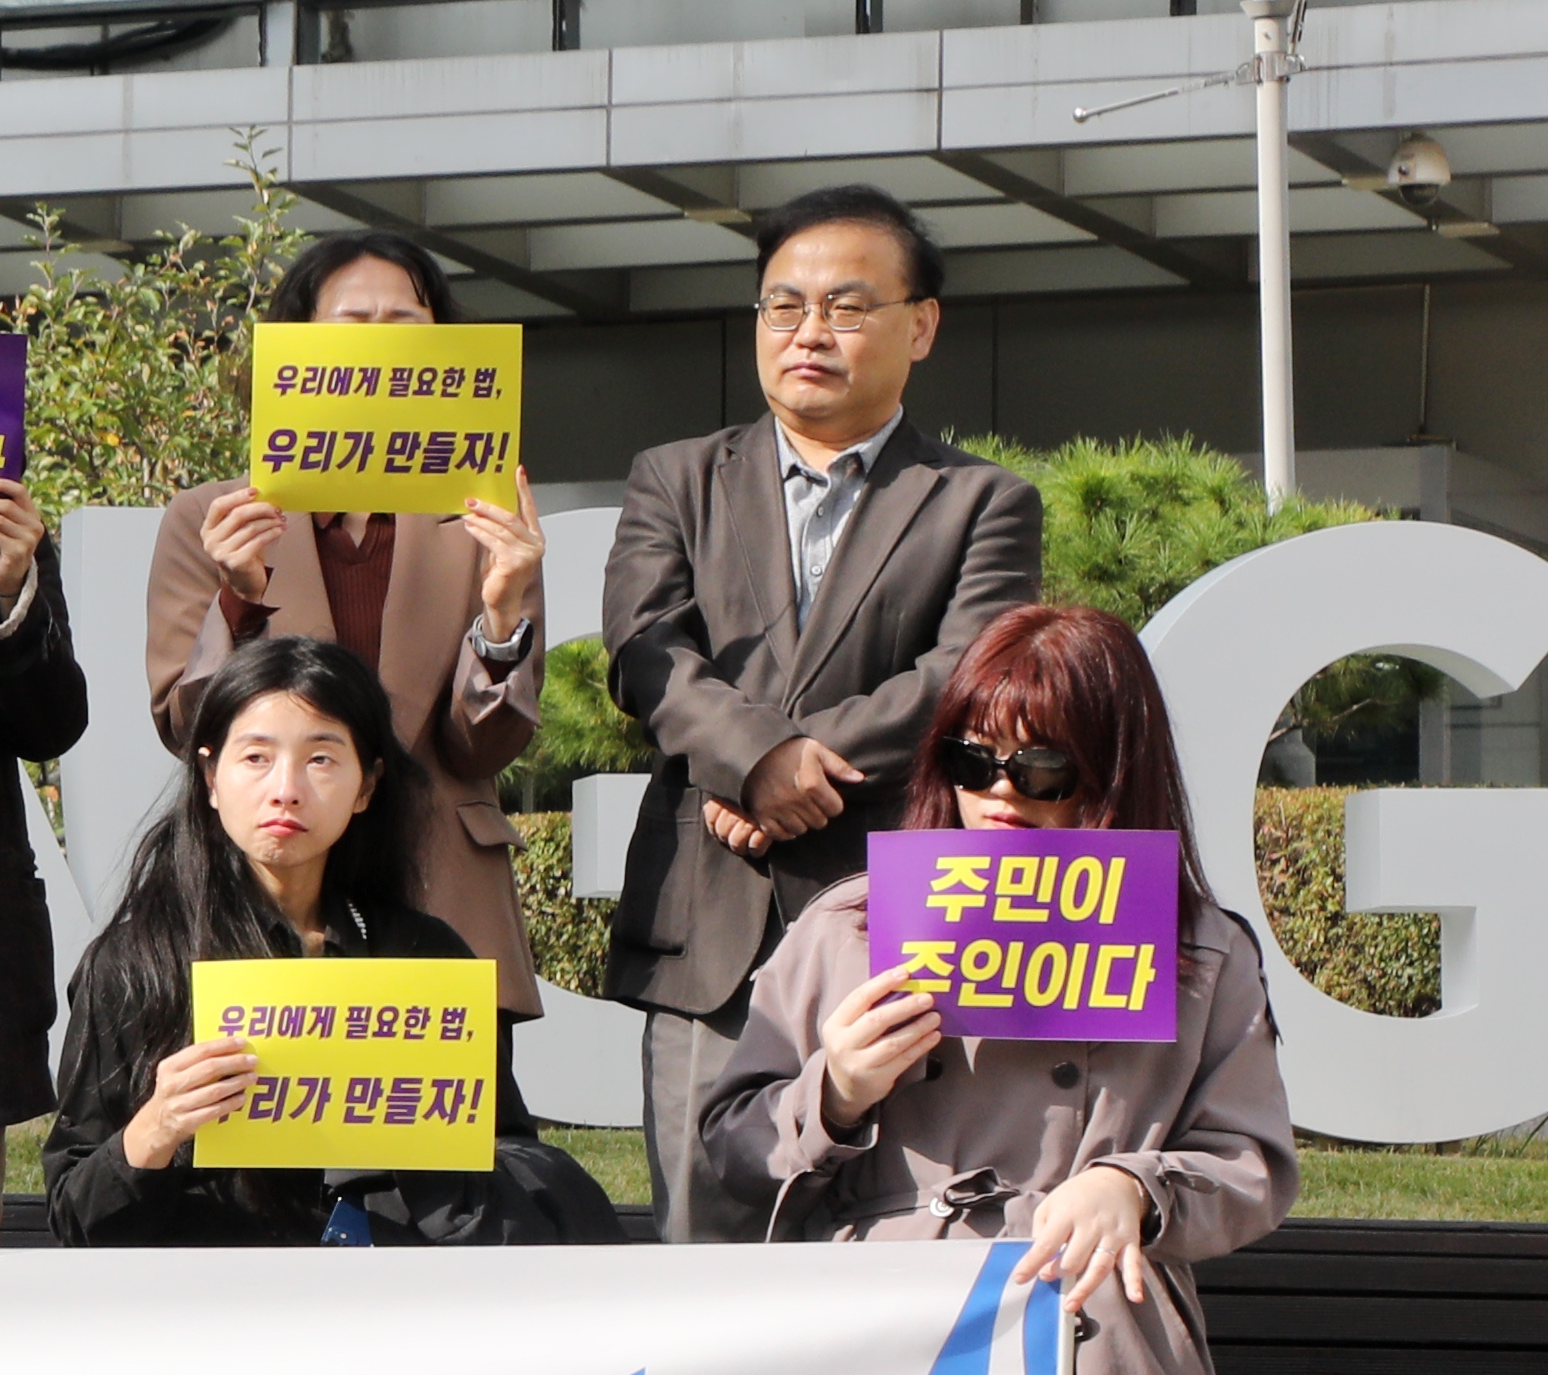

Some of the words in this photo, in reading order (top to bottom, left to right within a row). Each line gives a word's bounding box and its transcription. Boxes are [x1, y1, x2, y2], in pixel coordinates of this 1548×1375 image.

[277, 367, 379, 394] 우리에게
[391, 369, 463, 396] 필요한
[476, 371, 503, 400] 법,
[264, 430, 372, 471] 우리가
[386, 433, 507, 472] 만들자!
[927, 857, 1125, 923] 주민이
[222, 1008, 334, 1036] 우리에게
[348, 1007, 429, 1038] 필요한
[443, 1010, 474, 1042] 법,
[217, 1076, 329, 1122] 리가
[346, 1079, 482, 1123] 만들자!
